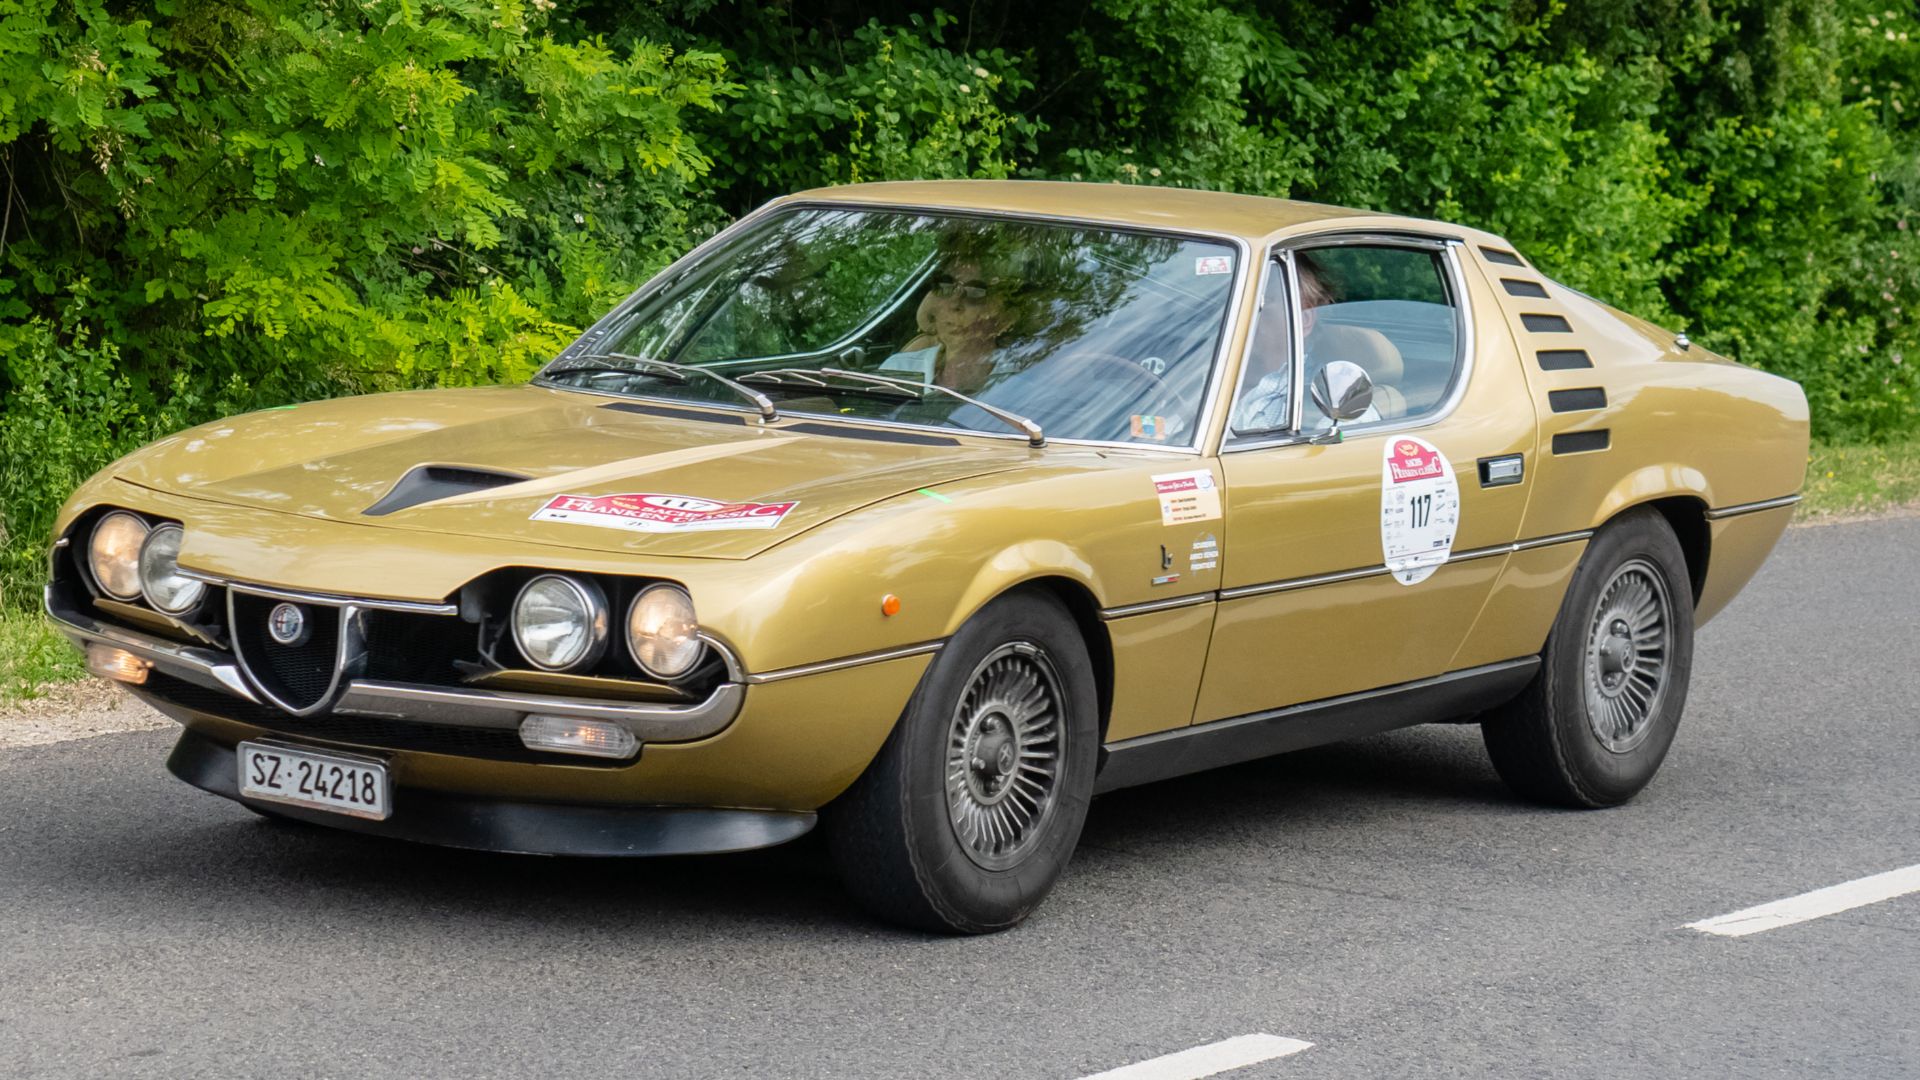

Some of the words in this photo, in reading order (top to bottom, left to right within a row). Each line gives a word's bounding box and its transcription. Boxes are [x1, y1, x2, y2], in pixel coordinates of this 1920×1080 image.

[557, 499, 667, 519] FRANKEN
[673, 505, 783, 522] CLASSIC
[662, 499, 711, 509] 117
[1411, 494, 1431, 528] 117
